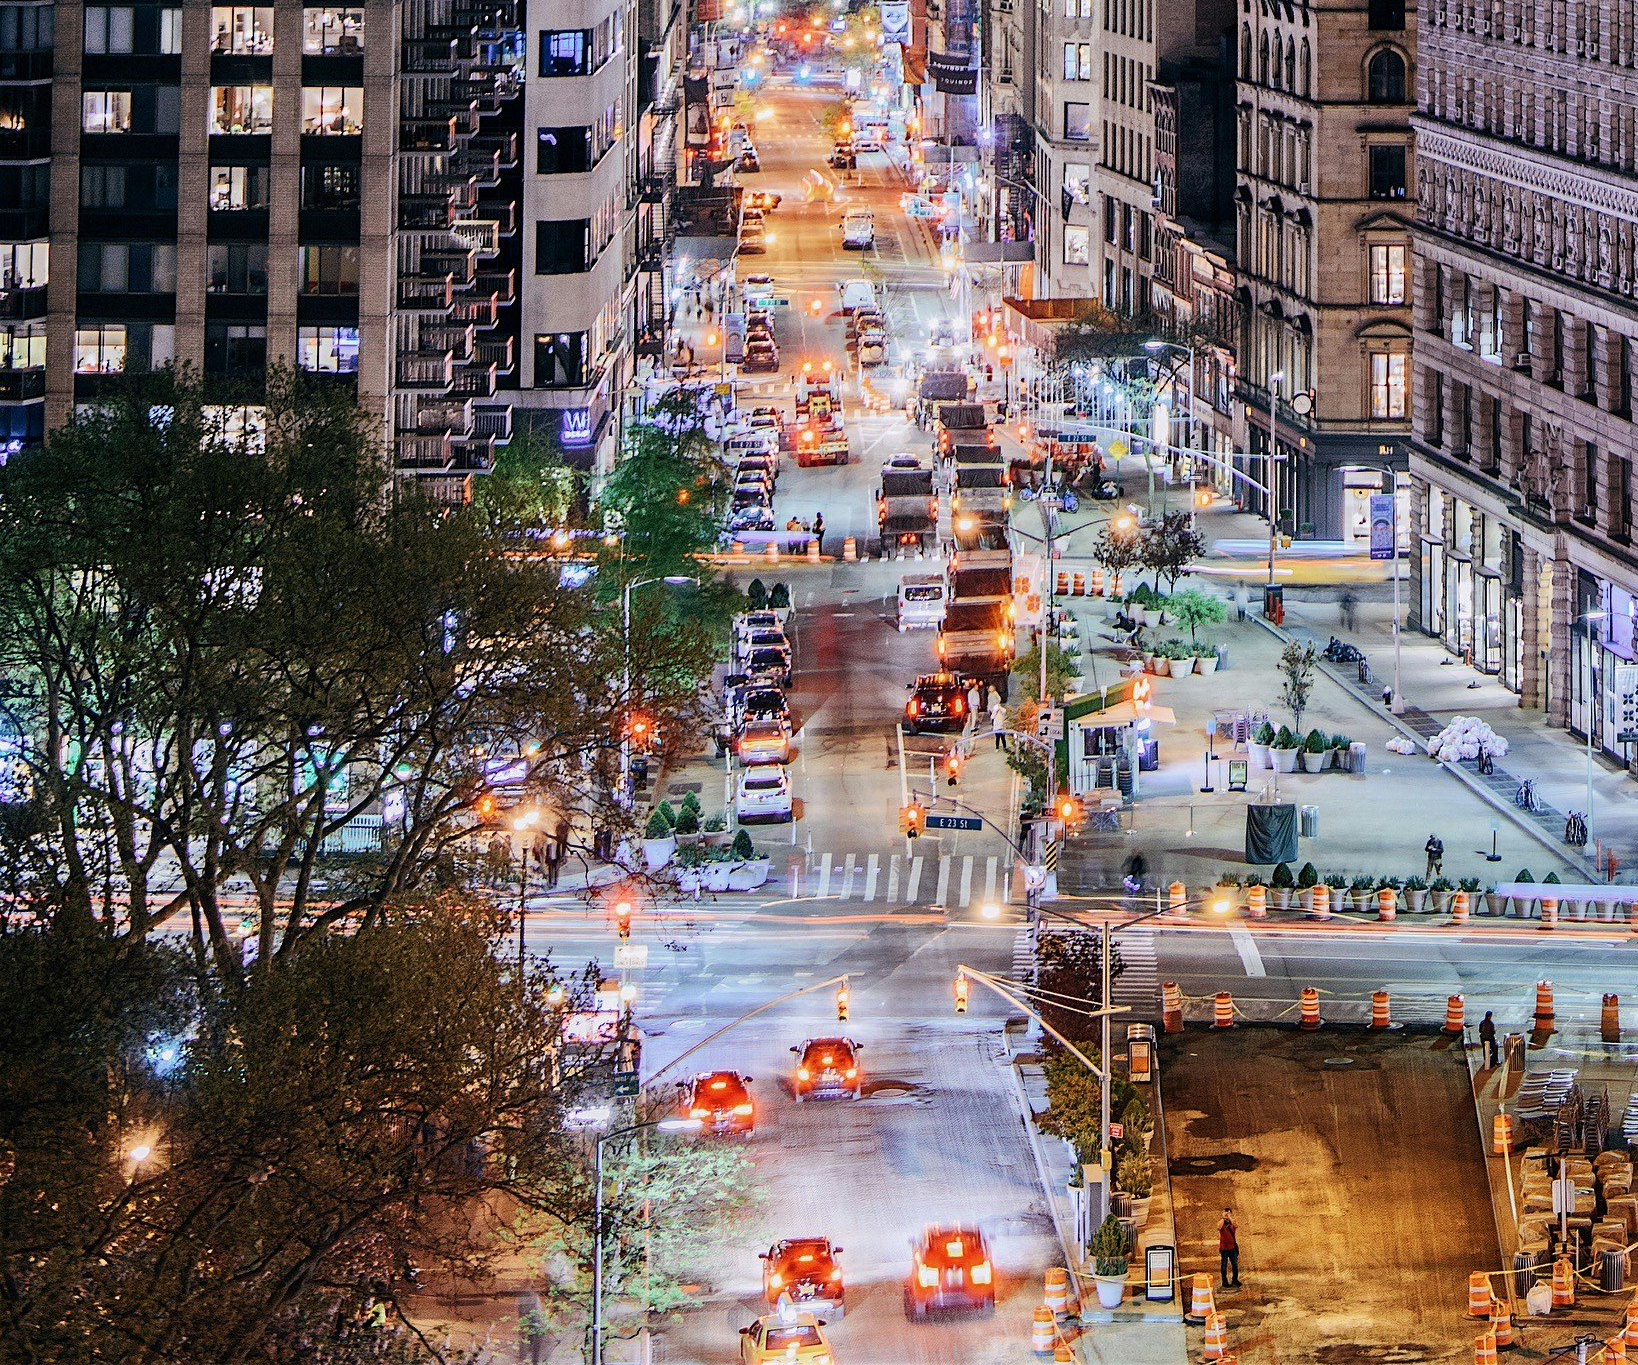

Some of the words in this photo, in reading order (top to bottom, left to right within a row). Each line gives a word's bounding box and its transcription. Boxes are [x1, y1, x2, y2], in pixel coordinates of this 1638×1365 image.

[940, 818, 944, 827] E
[947, 818, 957, 828] 23
[960, 819, 968, 829] St
